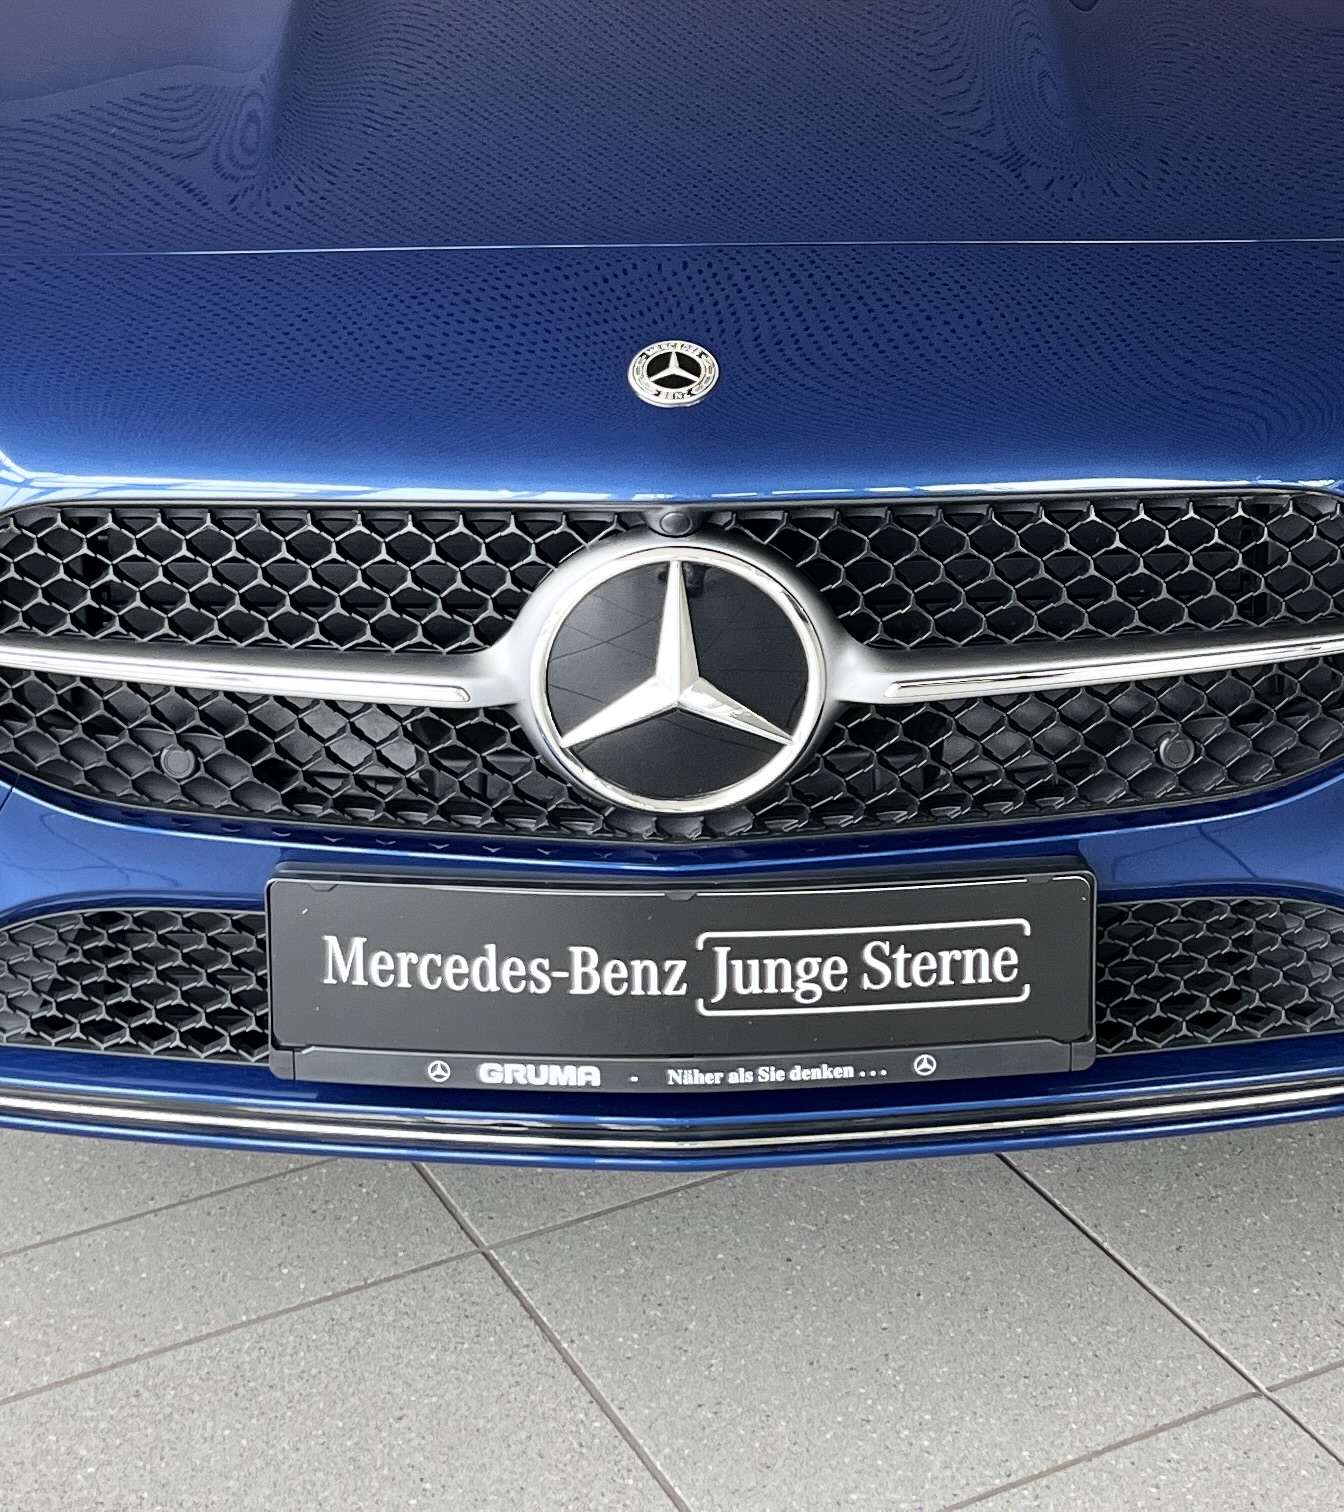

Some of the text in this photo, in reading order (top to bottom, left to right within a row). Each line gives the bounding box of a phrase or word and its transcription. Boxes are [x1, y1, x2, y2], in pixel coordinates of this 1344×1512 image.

[322, 935, 1019, 1003] Mercedes-Benz Junge Sterne
[479, 1062, 601, 1087] GRUMA
[667, 1068, 723, 1085] Näher
[728, 1067, 753, 1084] als
[757, 1065, 786, 1083] Sie
[790, 1064, 855, 1080] denken
